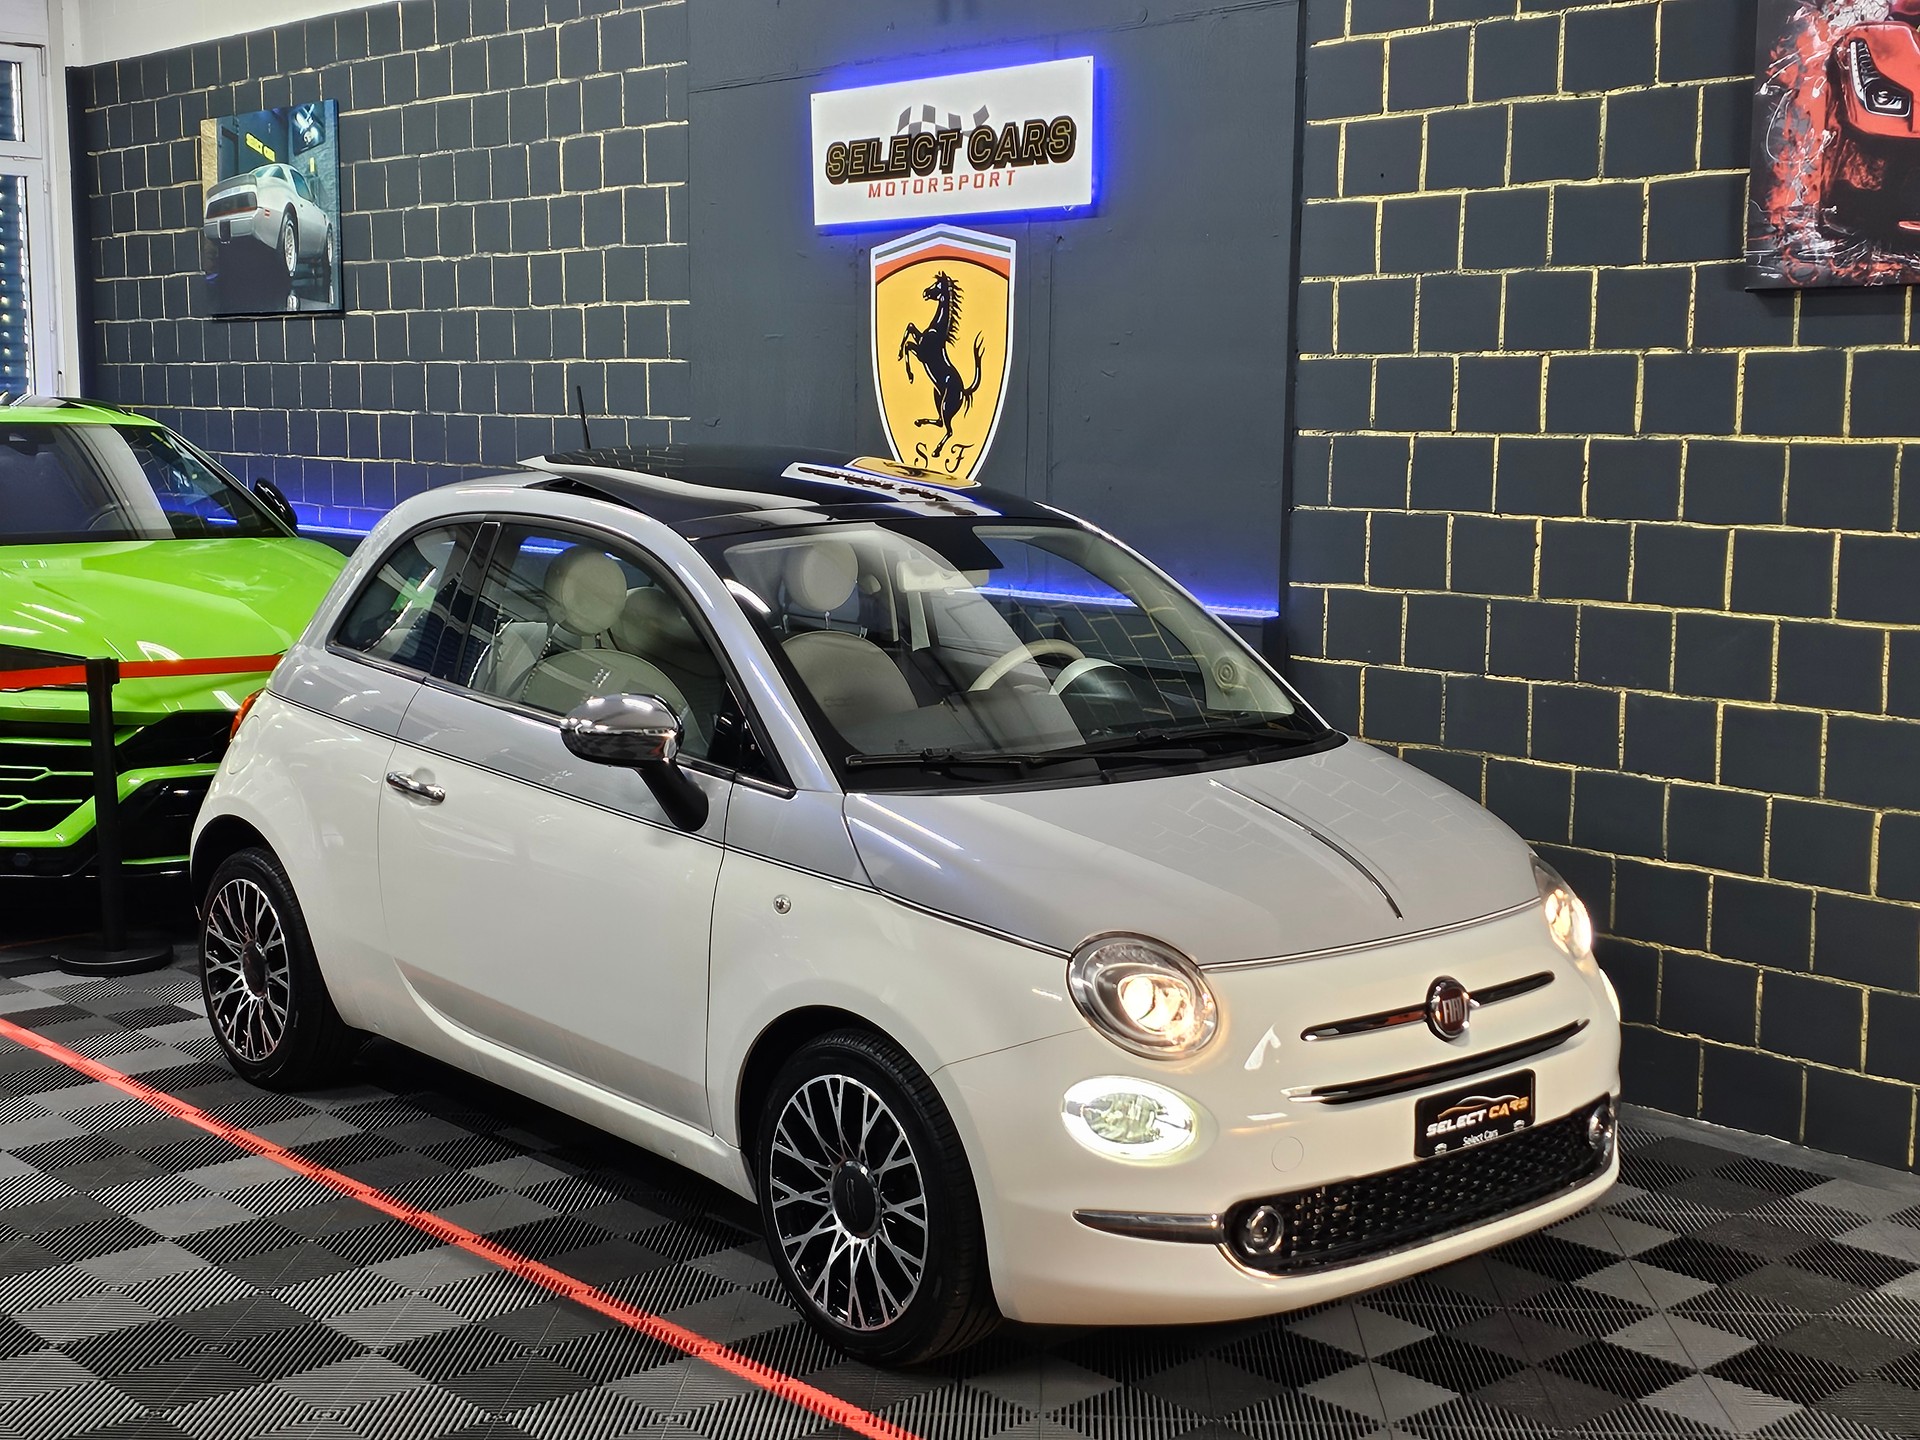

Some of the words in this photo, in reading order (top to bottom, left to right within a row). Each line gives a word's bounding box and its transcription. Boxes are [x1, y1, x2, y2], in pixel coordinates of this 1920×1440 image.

[826, 128, 962, 185] SELECT
[967, 115, 1077, 171] CARS
[868, 170, 1016, 198] MOTORSPORT
[1426, 1109, 1487, 1137] SELECT
[1488, 1096, 1529, 1119] CARS
